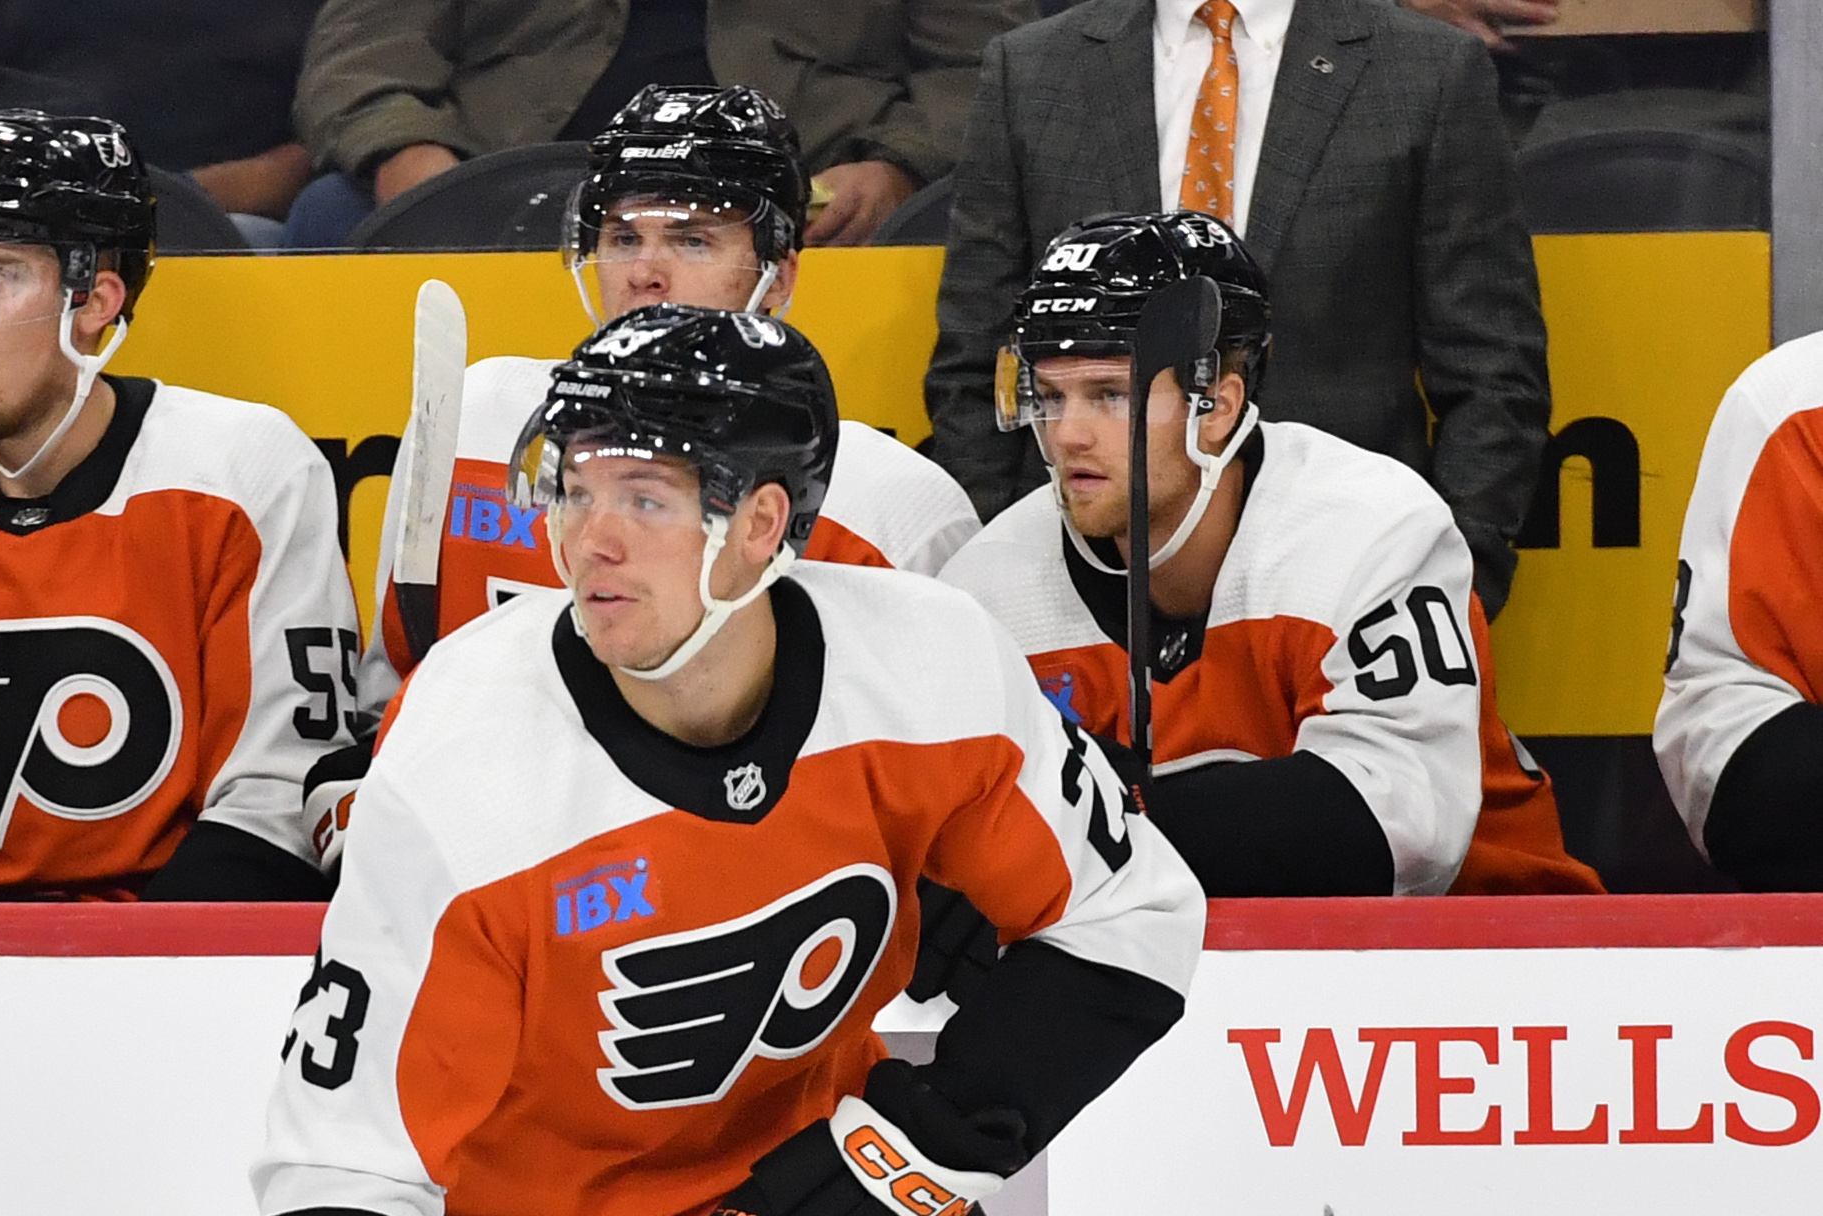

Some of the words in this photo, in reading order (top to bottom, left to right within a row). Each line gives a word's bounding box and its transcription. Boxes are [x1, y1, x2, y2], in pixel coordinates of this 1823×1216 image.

[1031, 298, 1097, 313] CCM
[555, 381, 611, 399] BAUER
[449, 495, 539, 549] IBX
[1347, 586, 1478, 701] 50
[556, 873, 657, 936] IBX
[1227, 1019, 1822, 1148] WELLS
